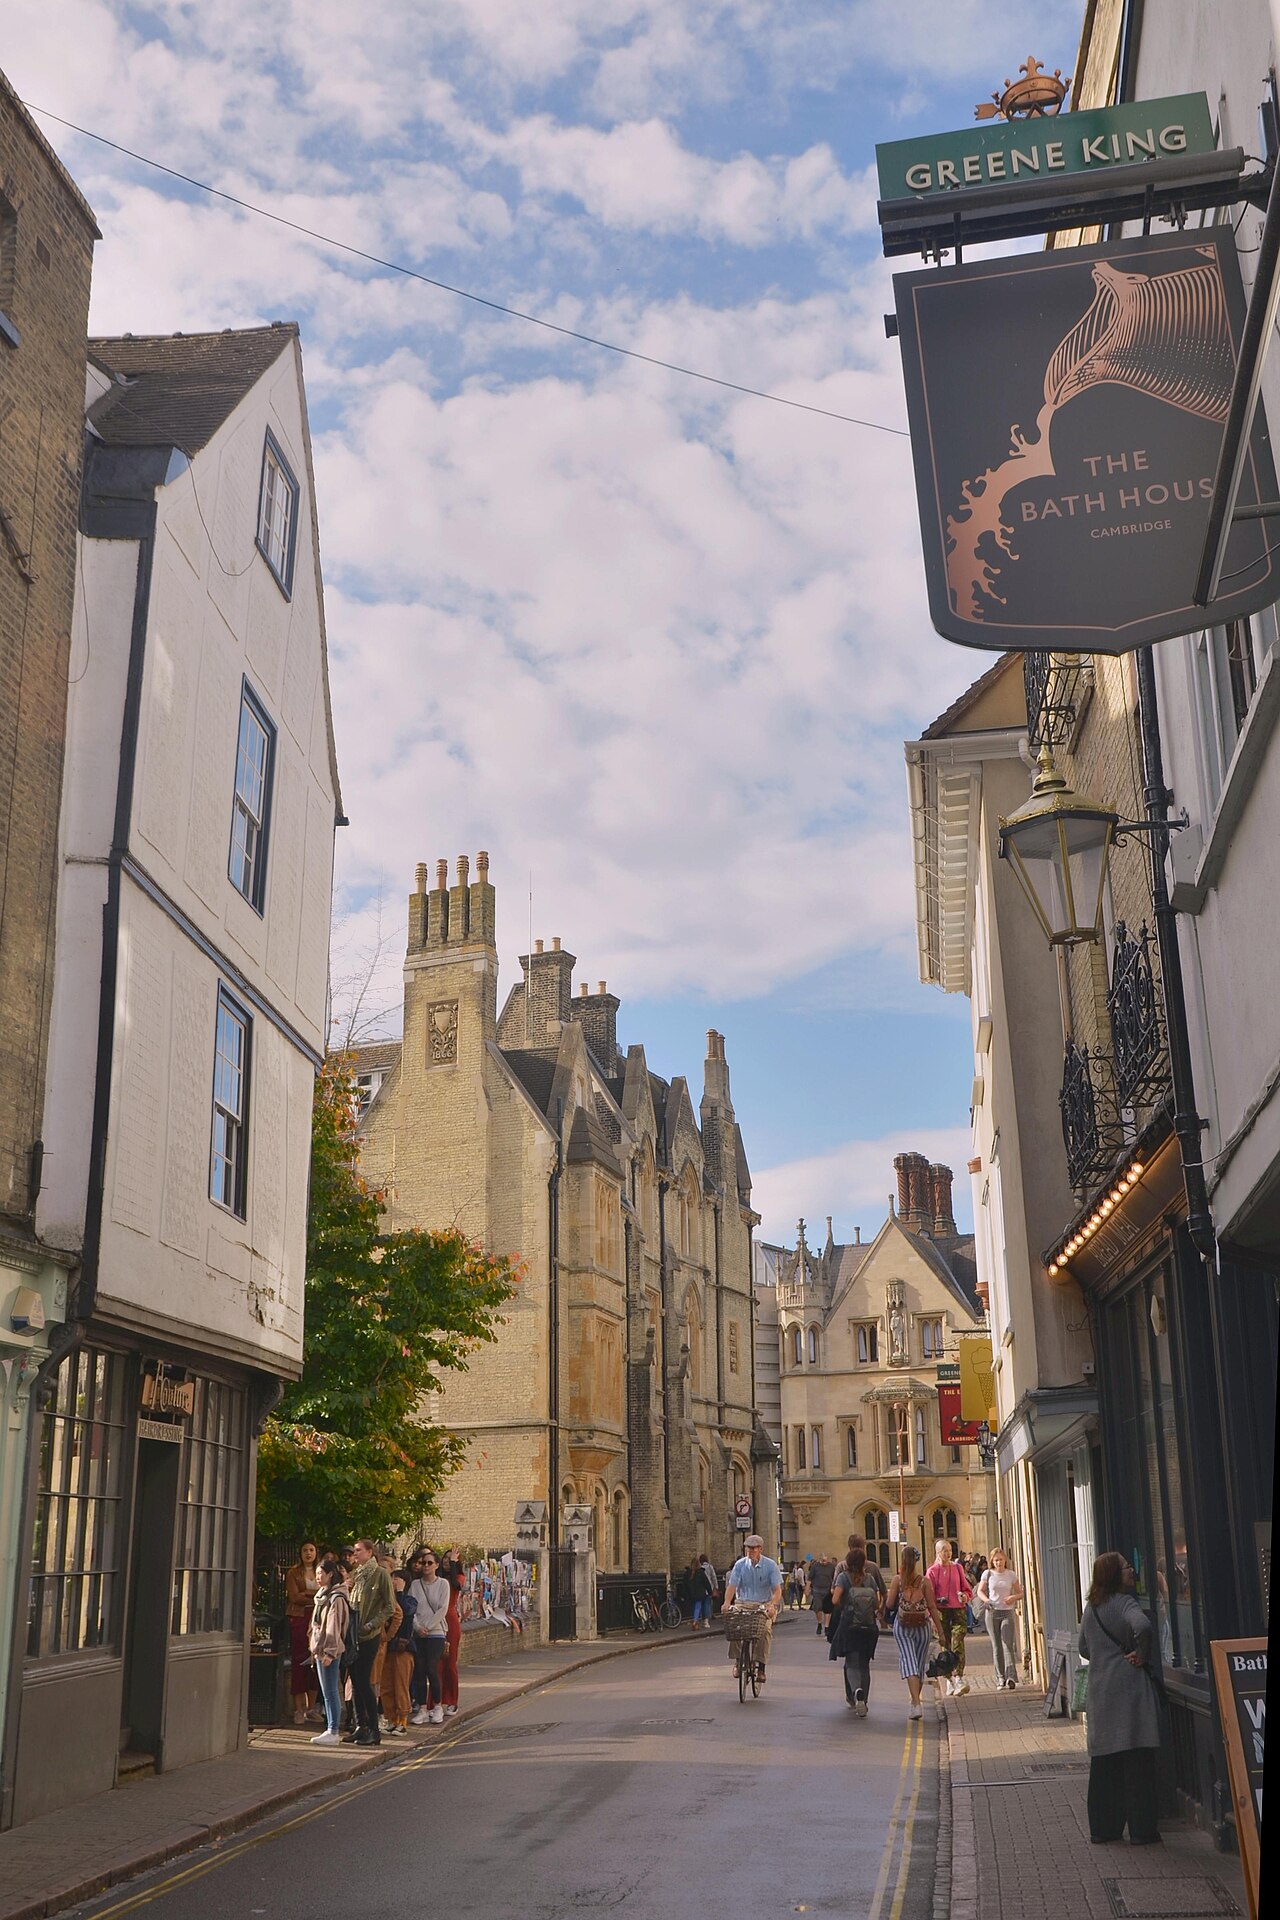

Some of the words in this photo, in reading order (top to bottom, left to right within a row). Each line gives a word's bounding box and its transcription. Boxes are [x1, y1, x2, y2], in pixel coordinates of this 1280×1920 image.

[905, 142, 1066, 190] GREENE
[1082, 124, 1188, 163] KING
[1083, 450, 1149, 477] THE
[1021, 492, 1105, 522] BATH
[1120, 477, 1215, 509] HOUS
[1090, 519, 1172, 539] CAMBRIDGE
[1087, 1232, 1120, 1268] BREAD
[1106, 1209, 1141, 1245] MEAT
[139, 1420, 183, 1442] HAIRDRESSING
